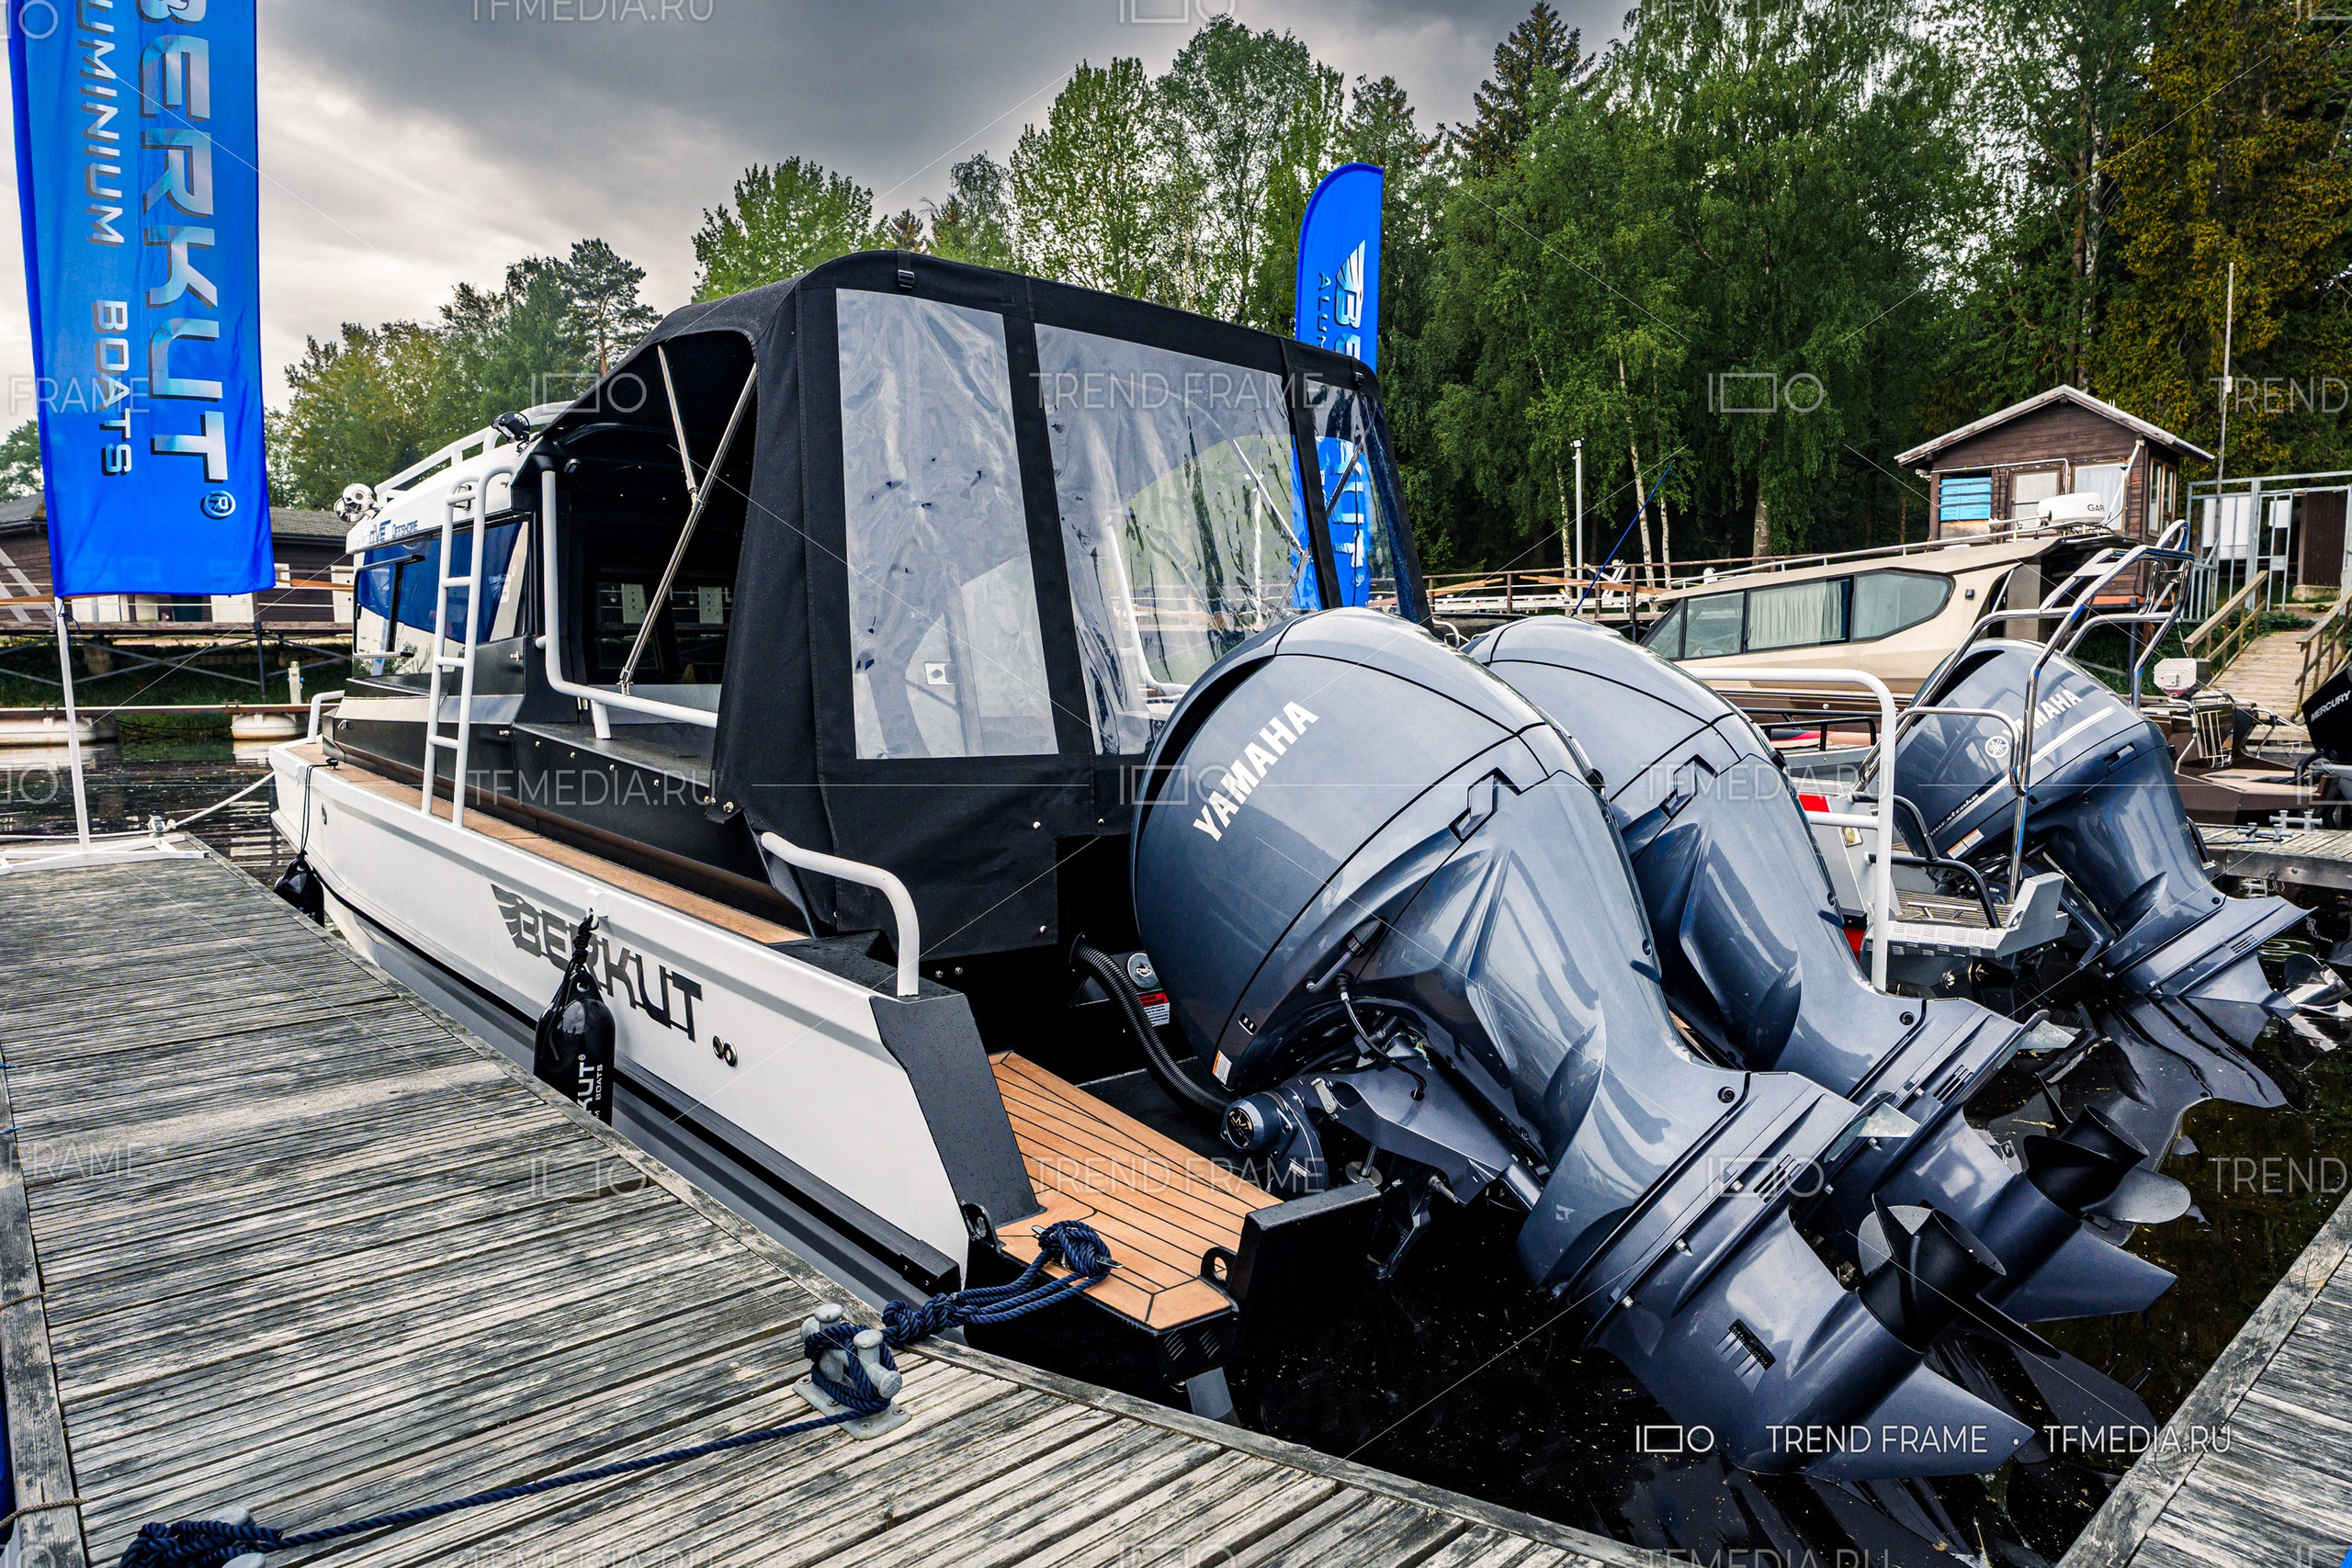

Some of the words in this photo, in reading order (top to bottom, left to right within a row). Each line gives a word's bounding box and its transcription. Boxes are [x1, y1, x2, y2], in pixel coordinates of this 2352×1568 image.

[77, 0, 125, 246] UMINIUM
[92, 299, 132, 477] BOATS
[2086, 503, 2105, 512] GAR
[1193, 701, 1319, 842] YAMAHA
[2310, 690, 2351, 723] MERCURY
